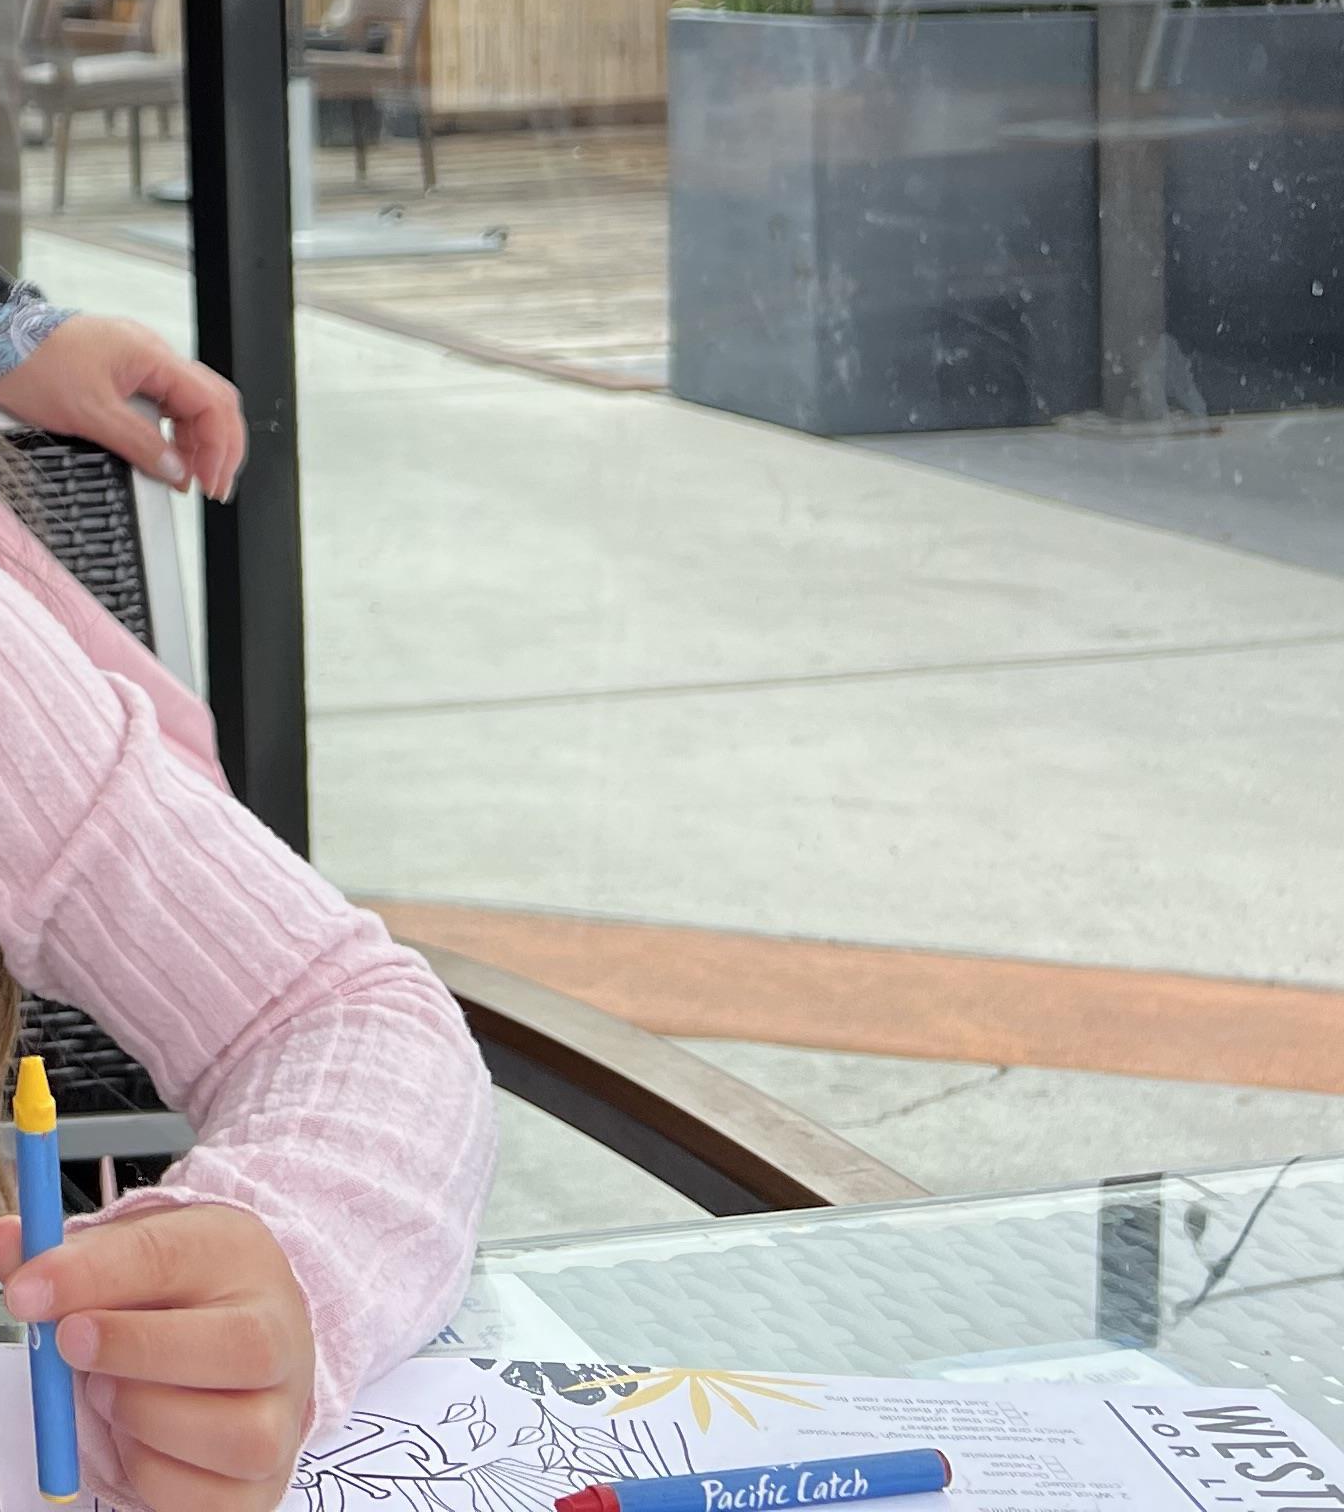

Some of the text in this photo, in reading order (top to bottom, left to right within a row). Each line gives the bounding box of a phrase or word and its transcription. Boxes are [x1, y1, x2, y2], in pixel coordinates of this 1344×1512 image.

[1132, 1405, 1200, 1458] FOR
[1182, 1405, 1344, 1512] WEST
[700, 1468, 869, 1512] Pacific Catch
